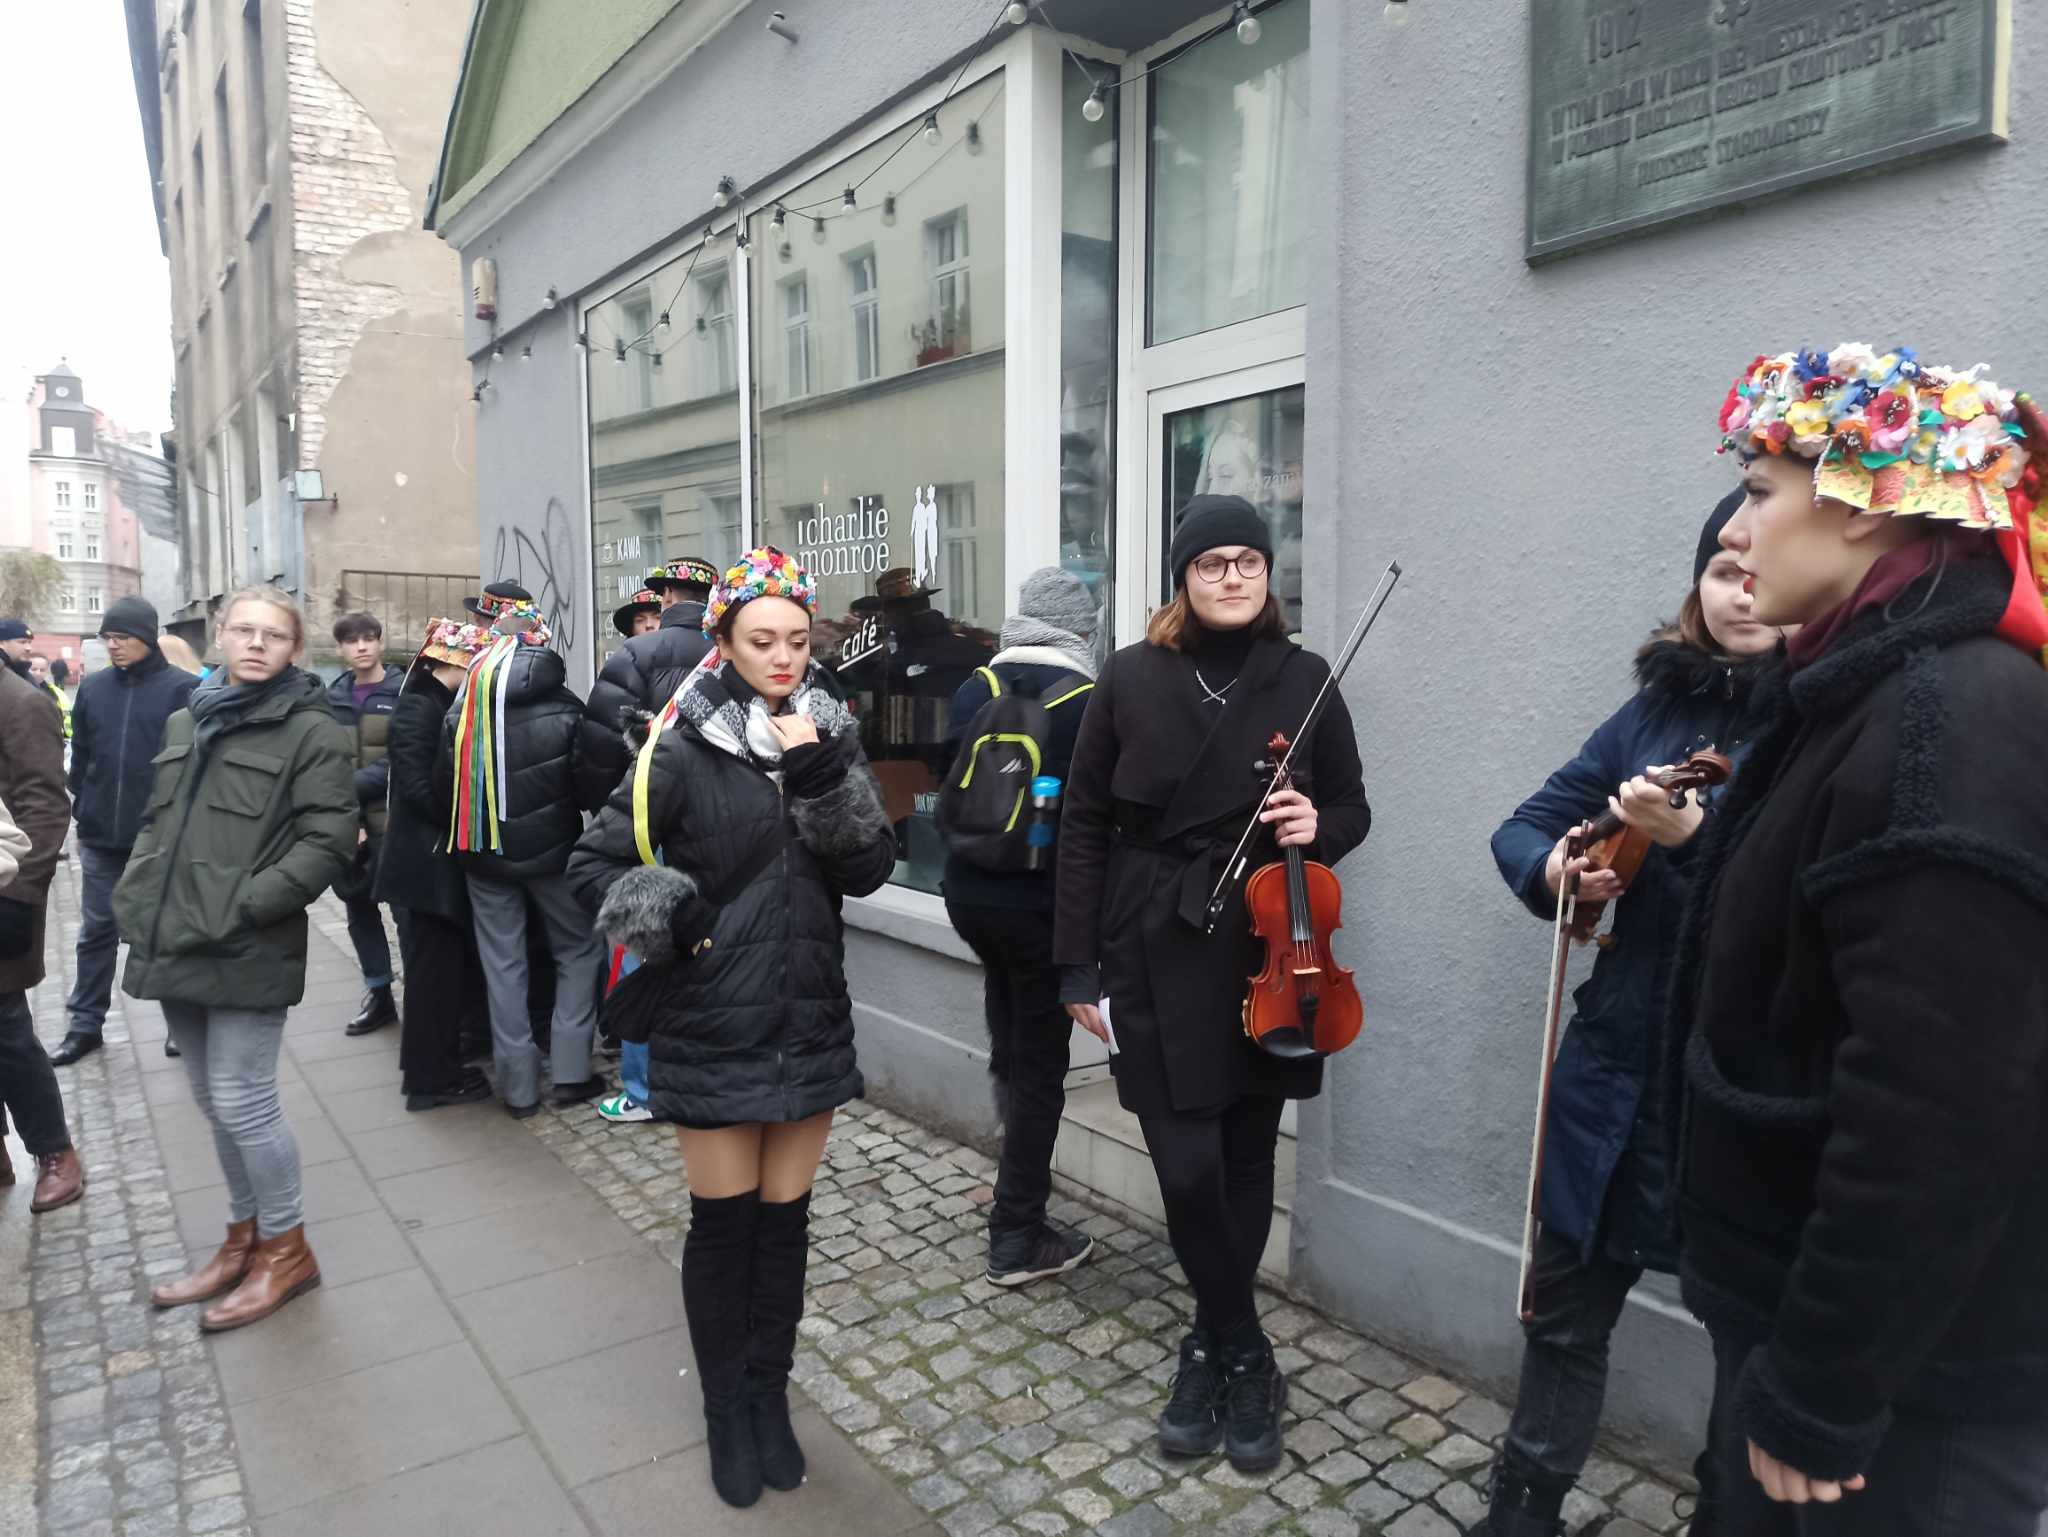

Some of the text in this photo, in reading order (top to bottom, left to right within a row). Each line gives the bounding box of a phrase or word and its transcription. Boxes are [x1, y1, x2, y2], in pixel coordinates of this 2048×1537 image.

[806, 496, 890, 546] charlie
[617, 535, 641, 561] KAWA
[799, 542, 890, 577] monroe
[618, 575, 641, 600] WINO
[841, 615, 877, 662] café
